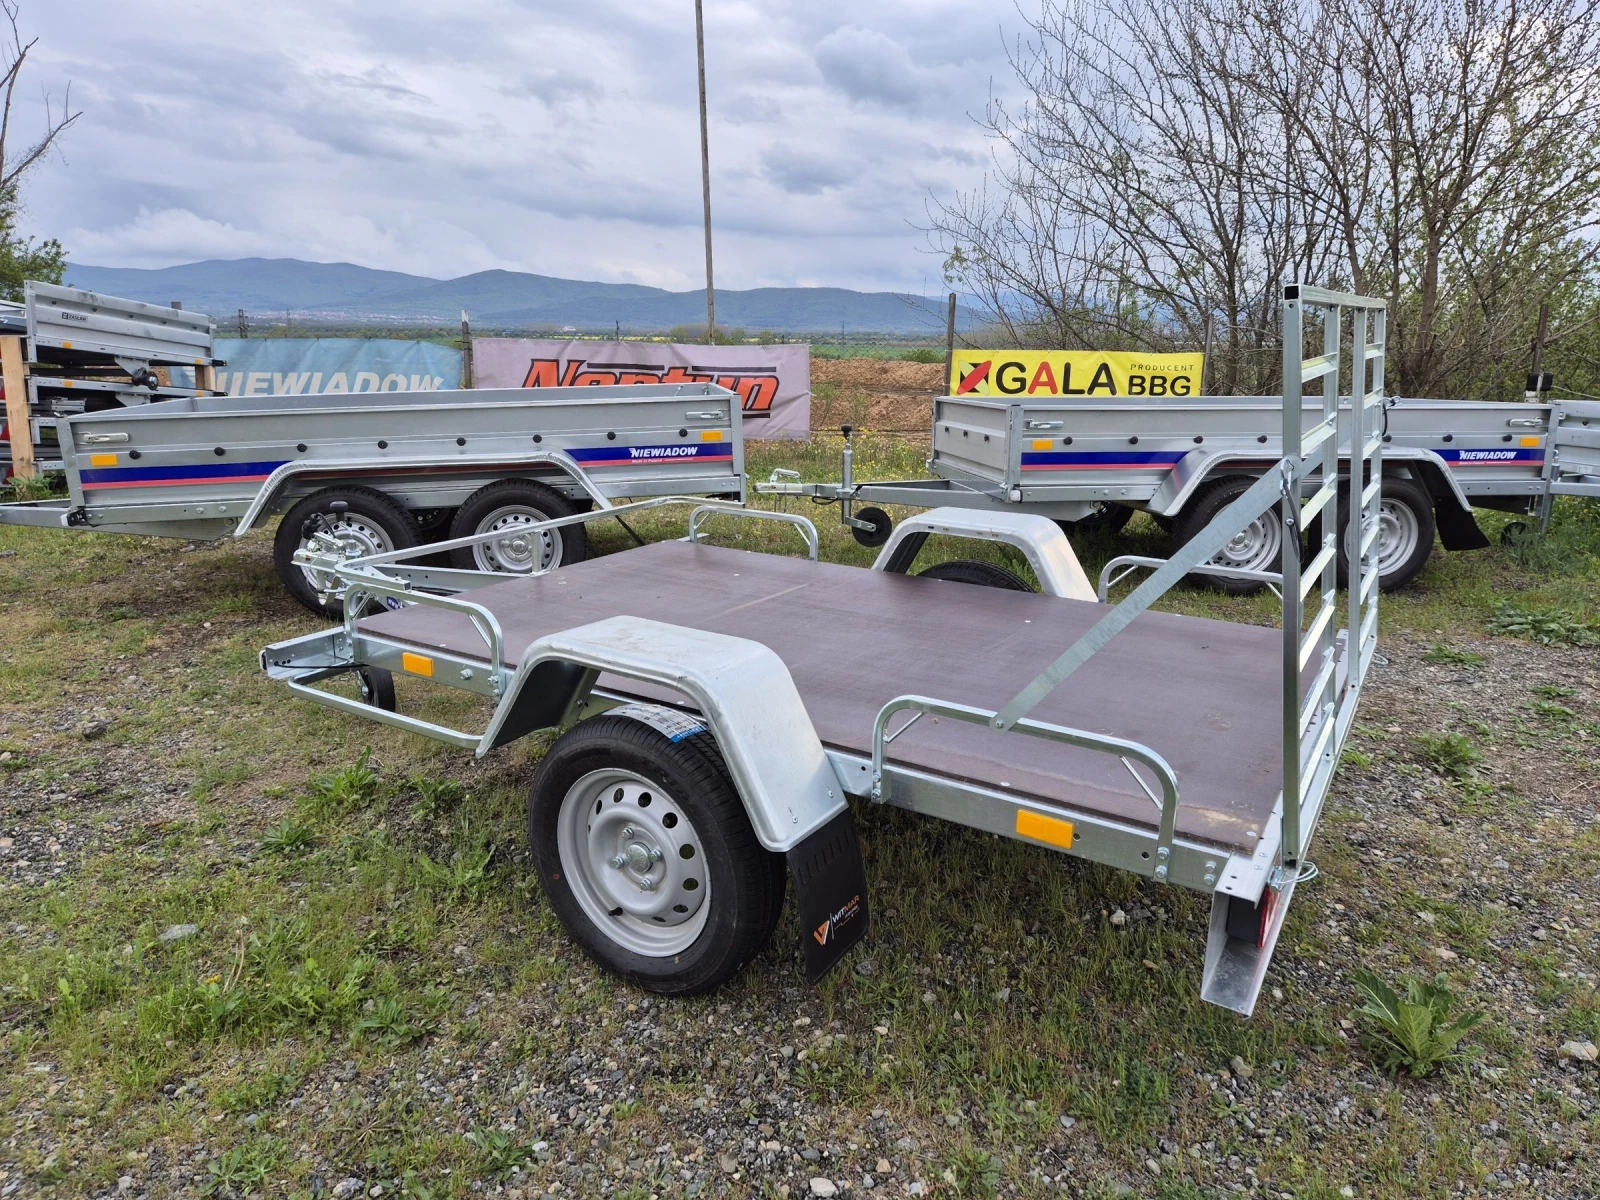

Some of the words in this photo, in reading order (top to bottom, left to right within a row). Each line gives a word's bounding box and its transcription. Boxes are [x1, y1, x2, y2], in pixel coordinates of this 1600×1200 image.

[1130, 363, 1194, 372] PRODUCENT
[996, 361, 1117, 395] GALA
[1127, 375, 1191, 396] BBG
[629, 446, 698, 458] NIEWIADOW
[1458, 450, 1517, 460] NIEWIADOW
[832, 895, 860, 923] WITMAR
